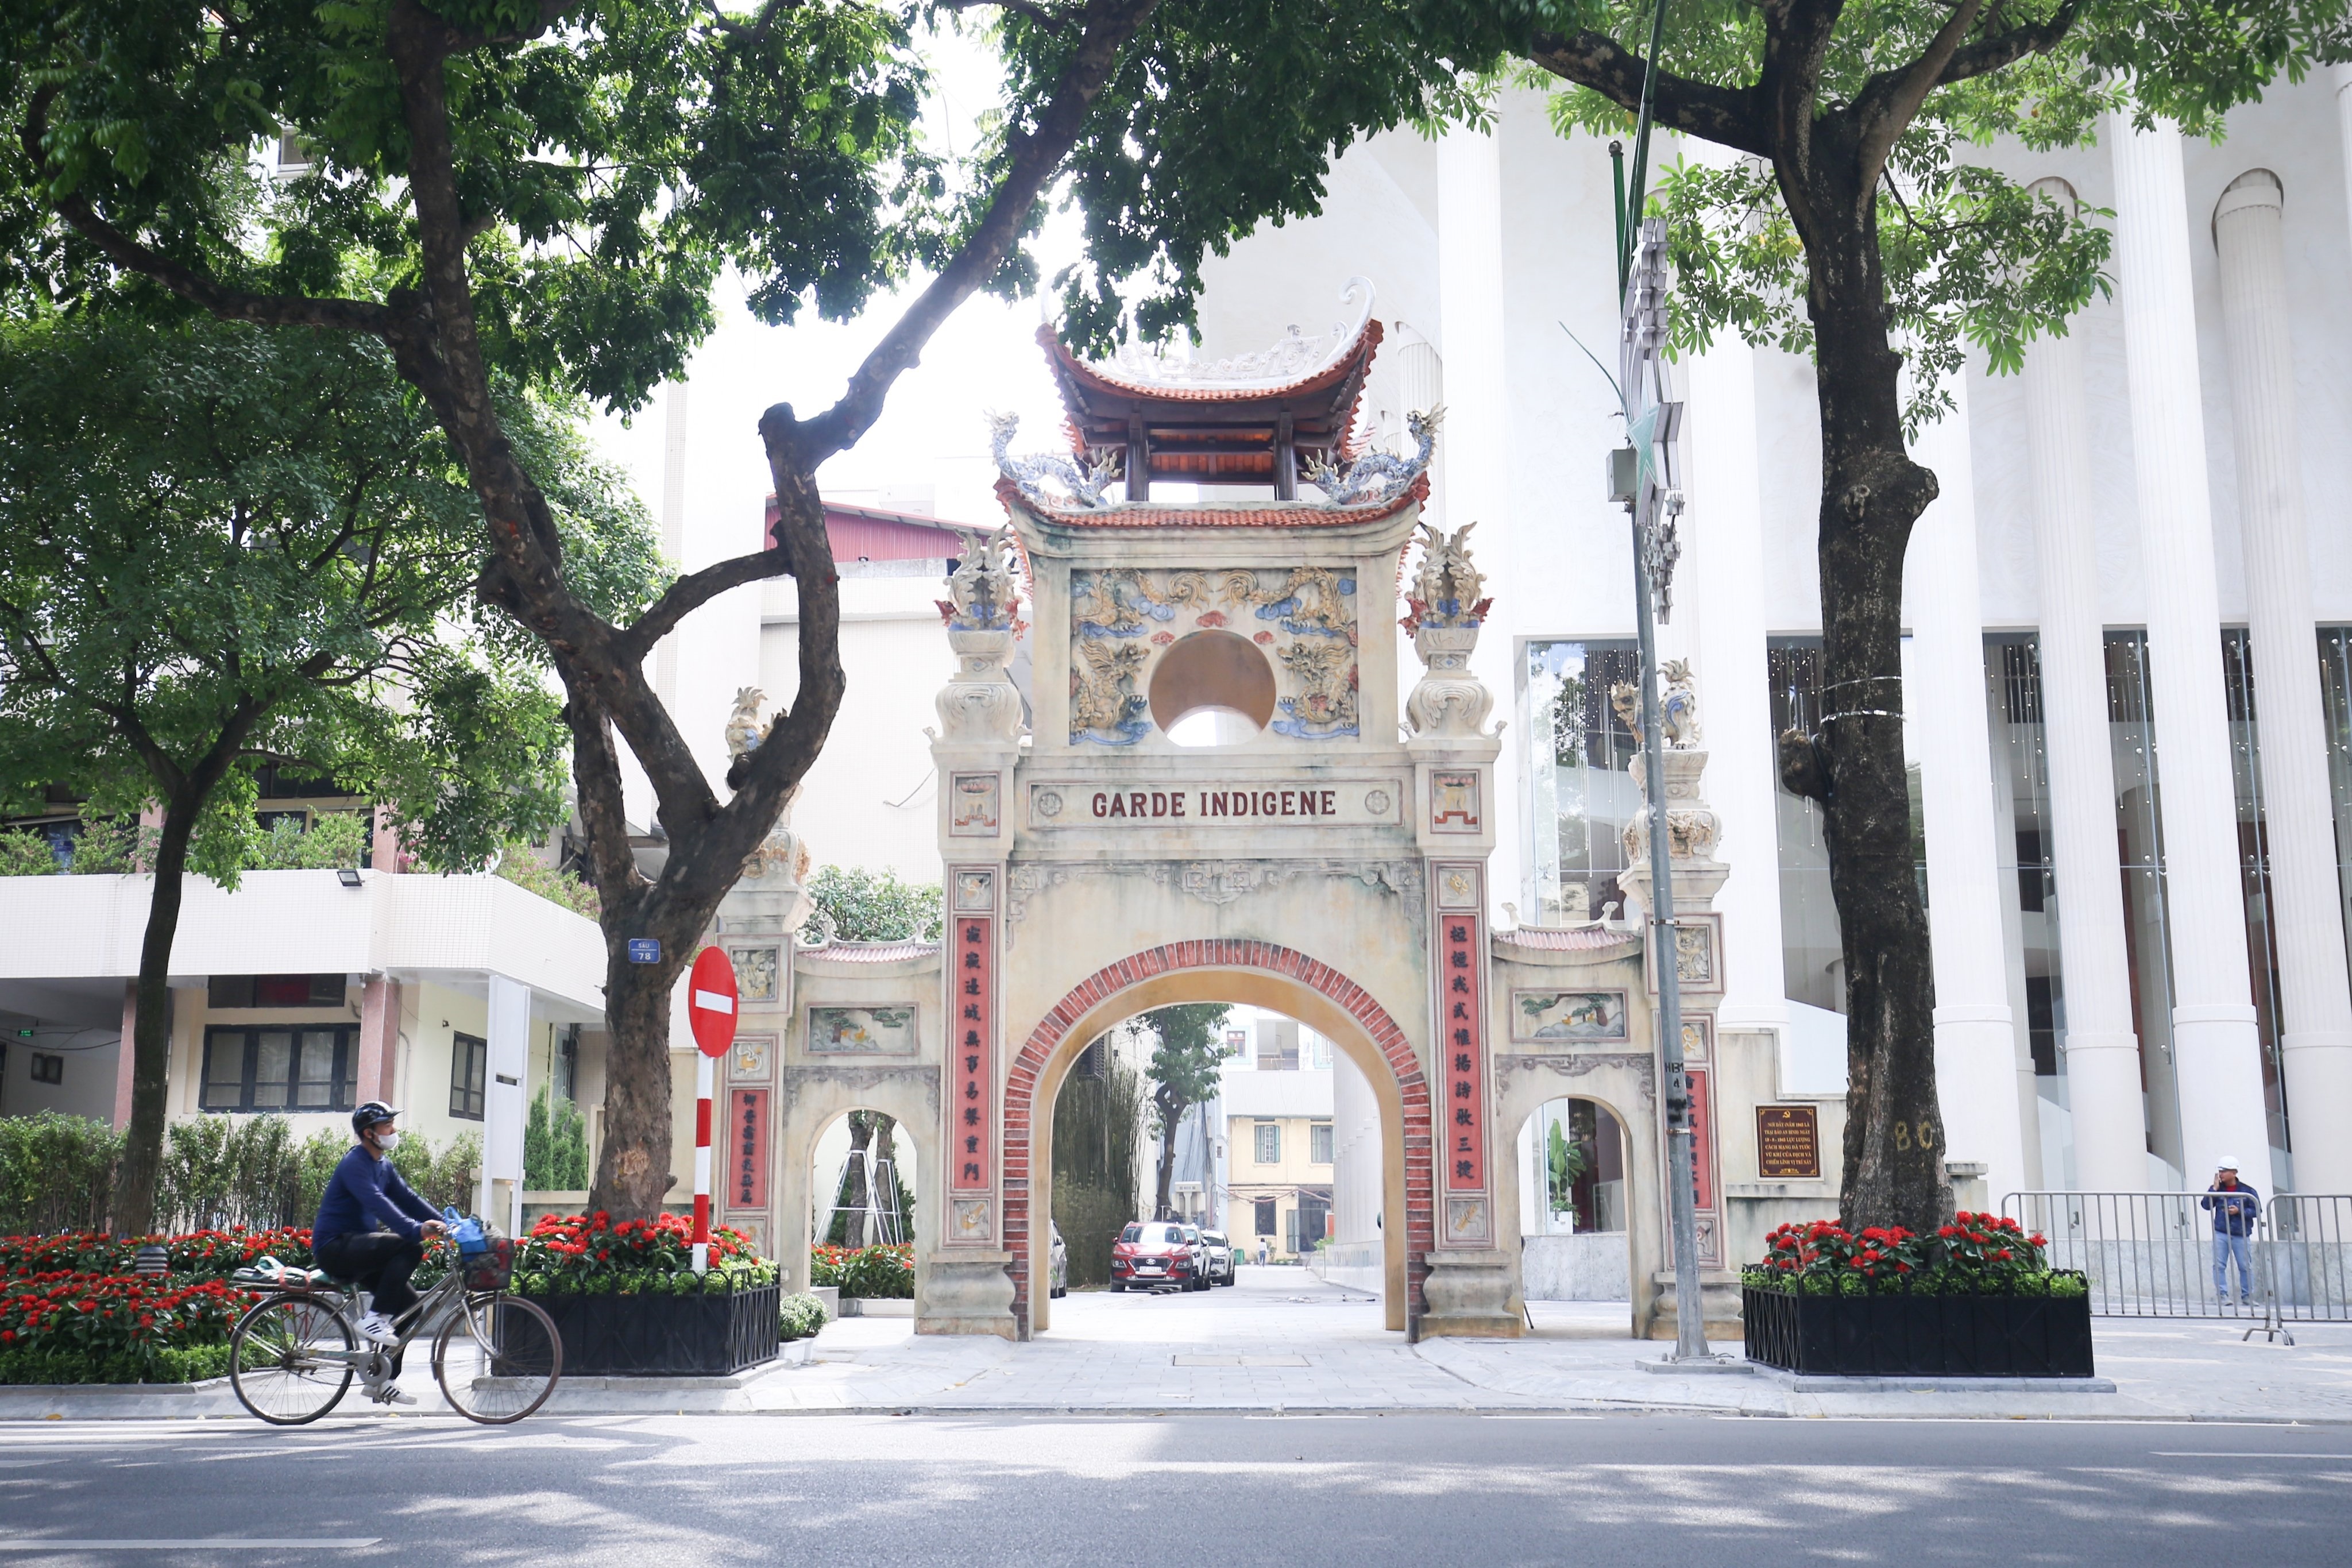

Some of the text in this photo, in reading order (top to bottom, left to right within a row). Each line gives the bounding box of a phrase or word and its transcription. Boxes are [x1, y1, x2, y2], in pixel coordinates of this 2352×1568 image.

[1092, 790, 1336, 817] GARDE INDIGENE
[1895, 1121, 1933, 1151] 80
